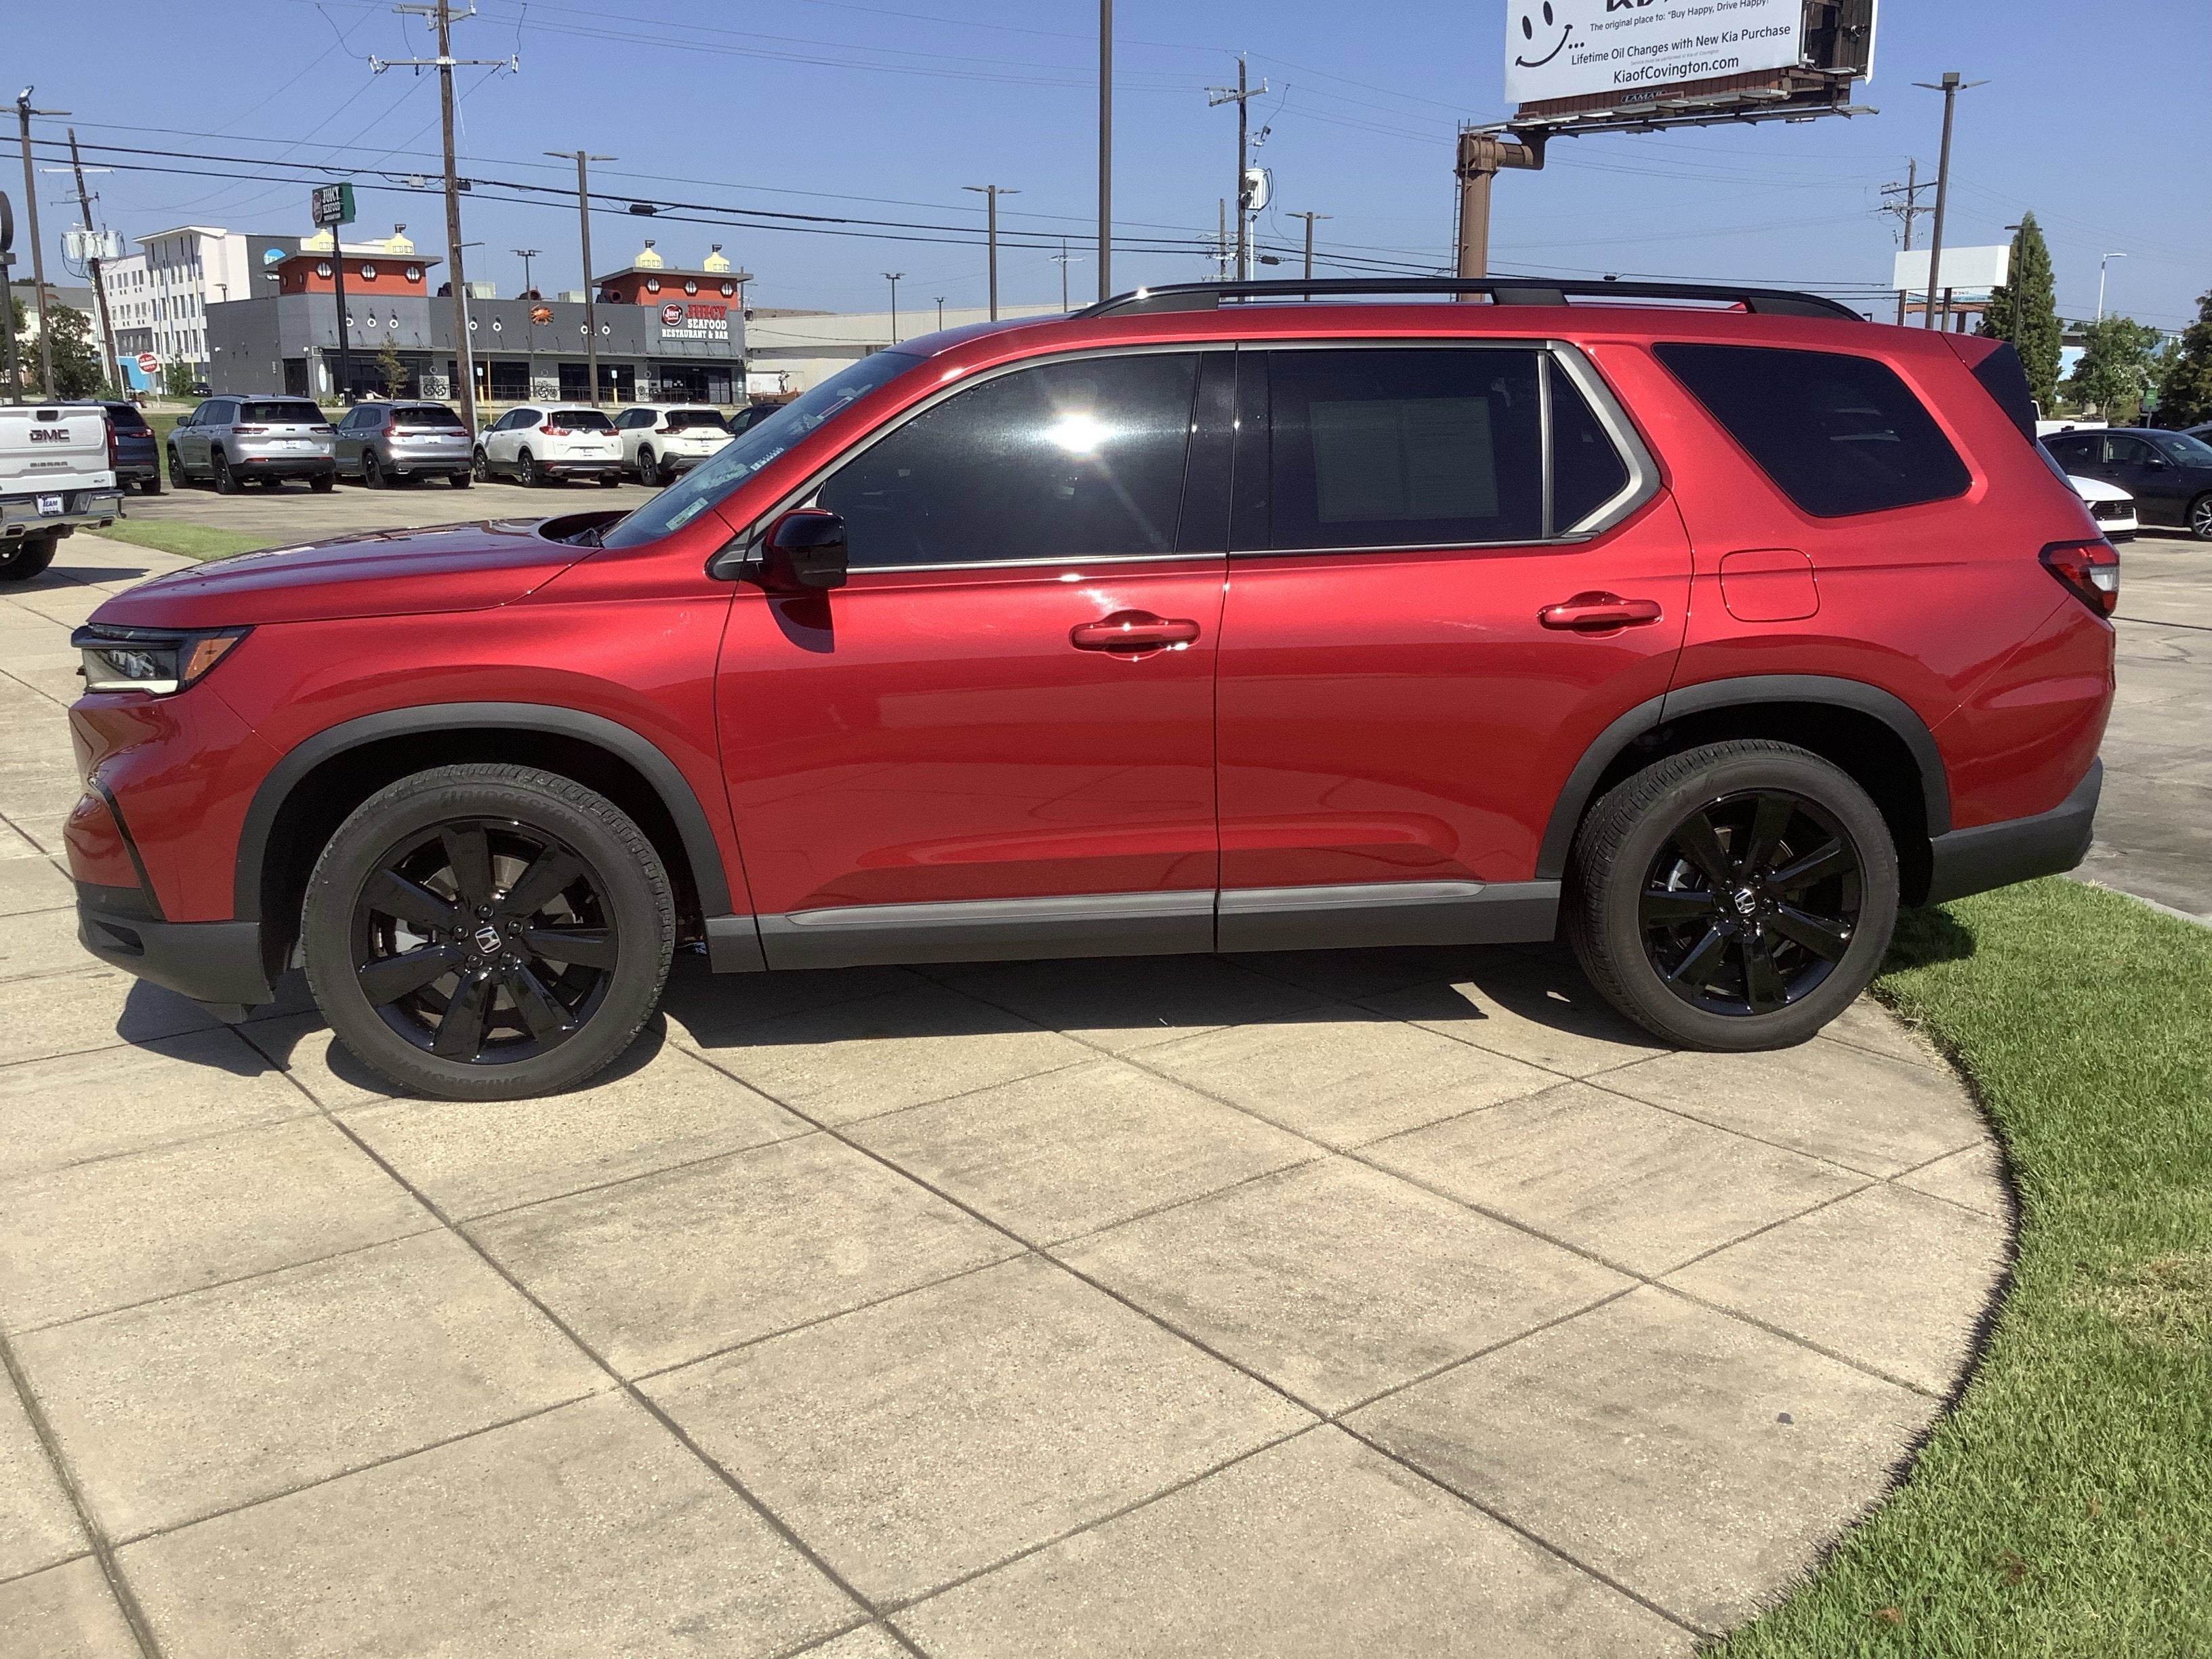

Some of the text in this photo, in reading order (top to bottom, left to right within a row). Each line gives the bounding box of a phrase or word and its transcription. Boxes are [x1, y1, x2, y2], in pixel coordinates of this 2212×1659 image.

[1590, 23, 1603, 31] The
[1605, 18, 1633, 30] original
[1634, 15, 1654, 26] place
[1687, 6, 1715, 16] Happy,
[1717, 2, 1738, 12] Drive
[1571, 26, 1790, 65] Lifetime Oil Changes with New Kia Purchase
[1614, 57, 1739, 84] KiaofCovington.com
[323, 186, 340, 203] JUICY
[323, 201, 341, 213] SEAFOOD
[684, 304, 726, 319] JUICY
[687, 319, 727, 330] SEAFOOD
[661, 329, 729, 340] RESTAURANT & BAR
[29, 429, 70, 443] GMC
[42, 498, 58, 508] TEAM
